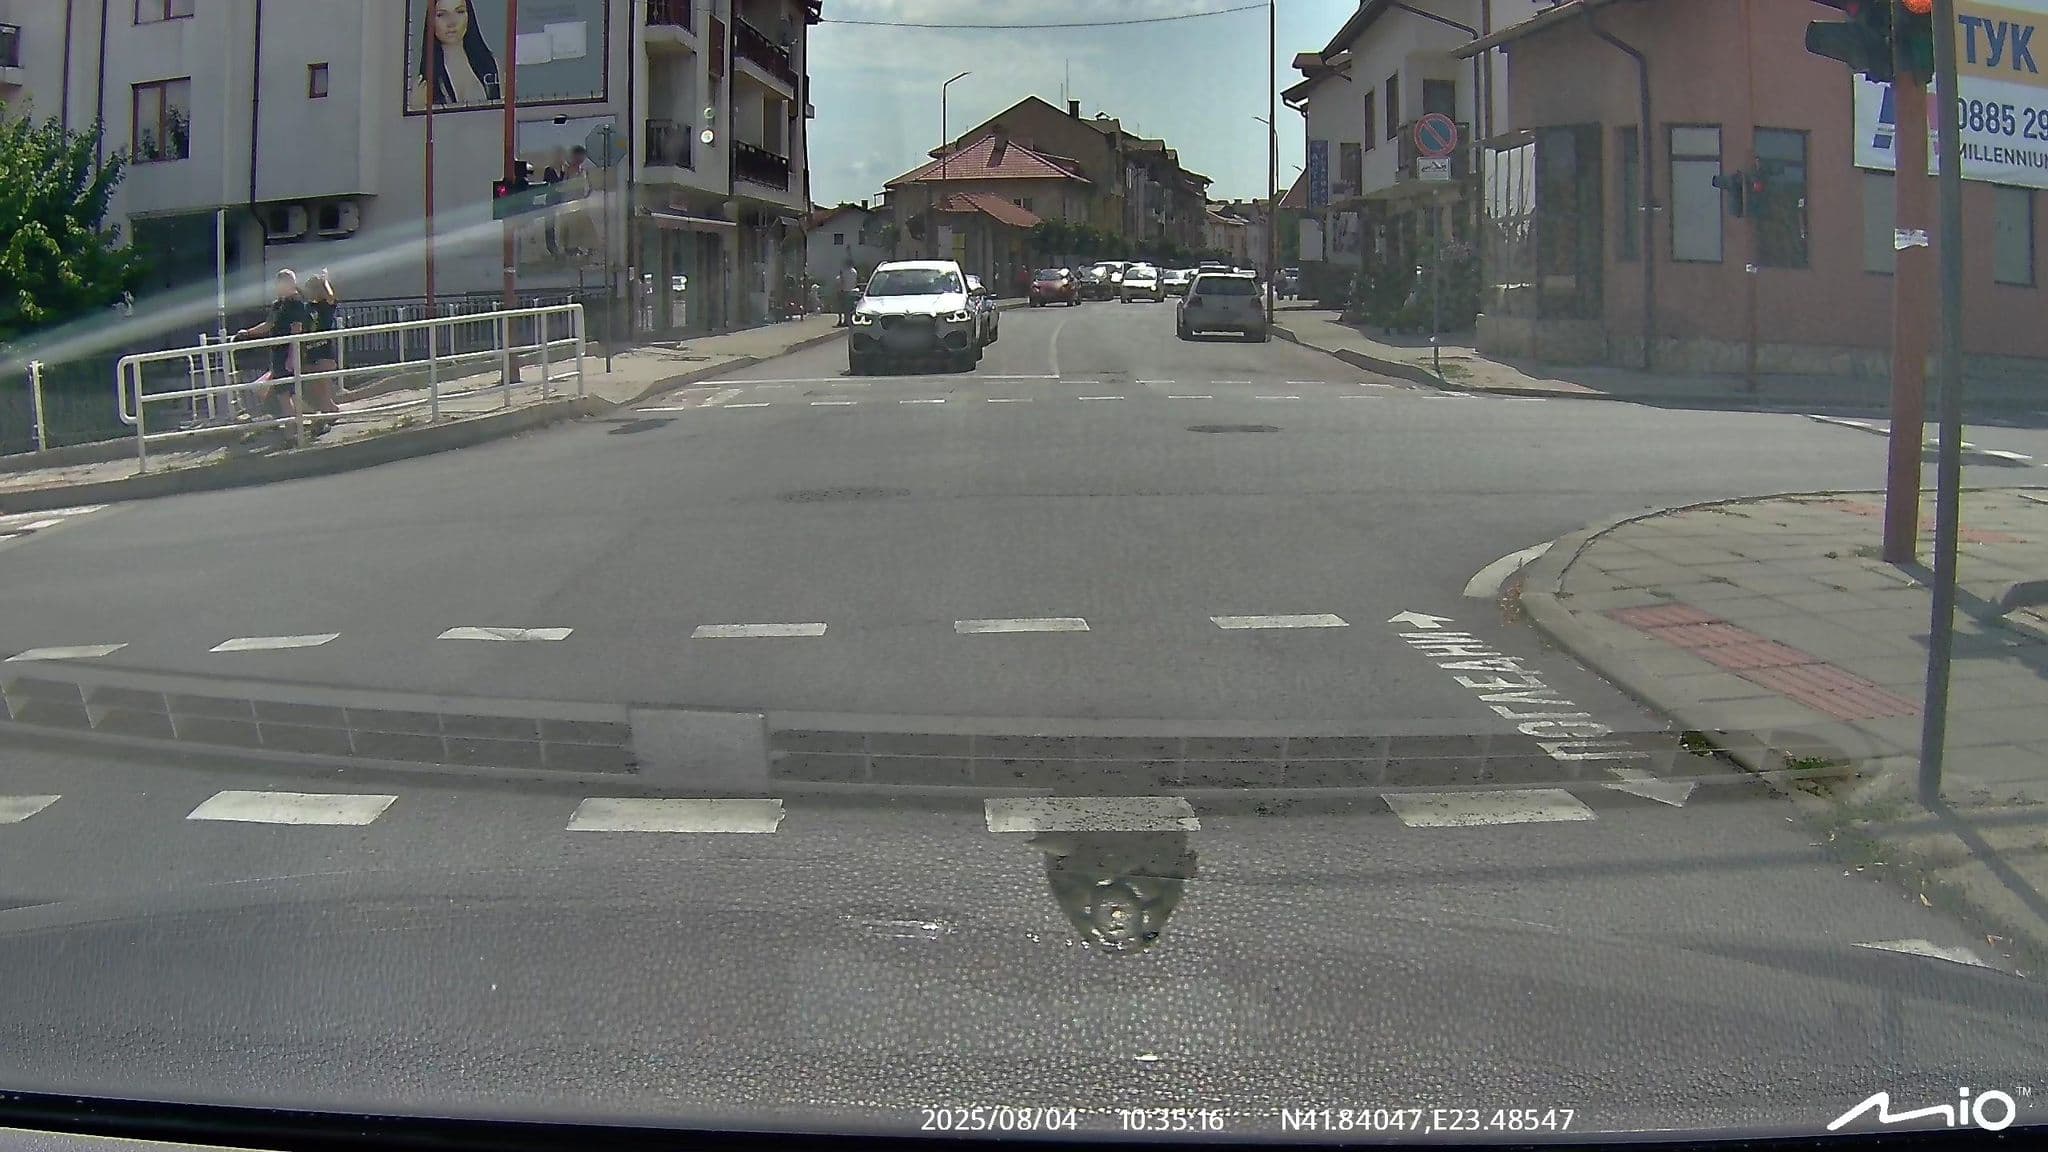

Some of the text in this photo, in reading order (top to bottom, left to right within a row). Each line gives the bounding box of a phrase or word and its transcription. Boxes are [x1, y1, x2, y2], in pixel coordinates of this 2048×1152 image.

[1958, 14, 2038, 74] ТУК
[484, 72, 506, 84] CL
[1958, 97, 2048, 141] 0885 29
[1399, 632, 1650, 761] ПОГЛЕДНИ
